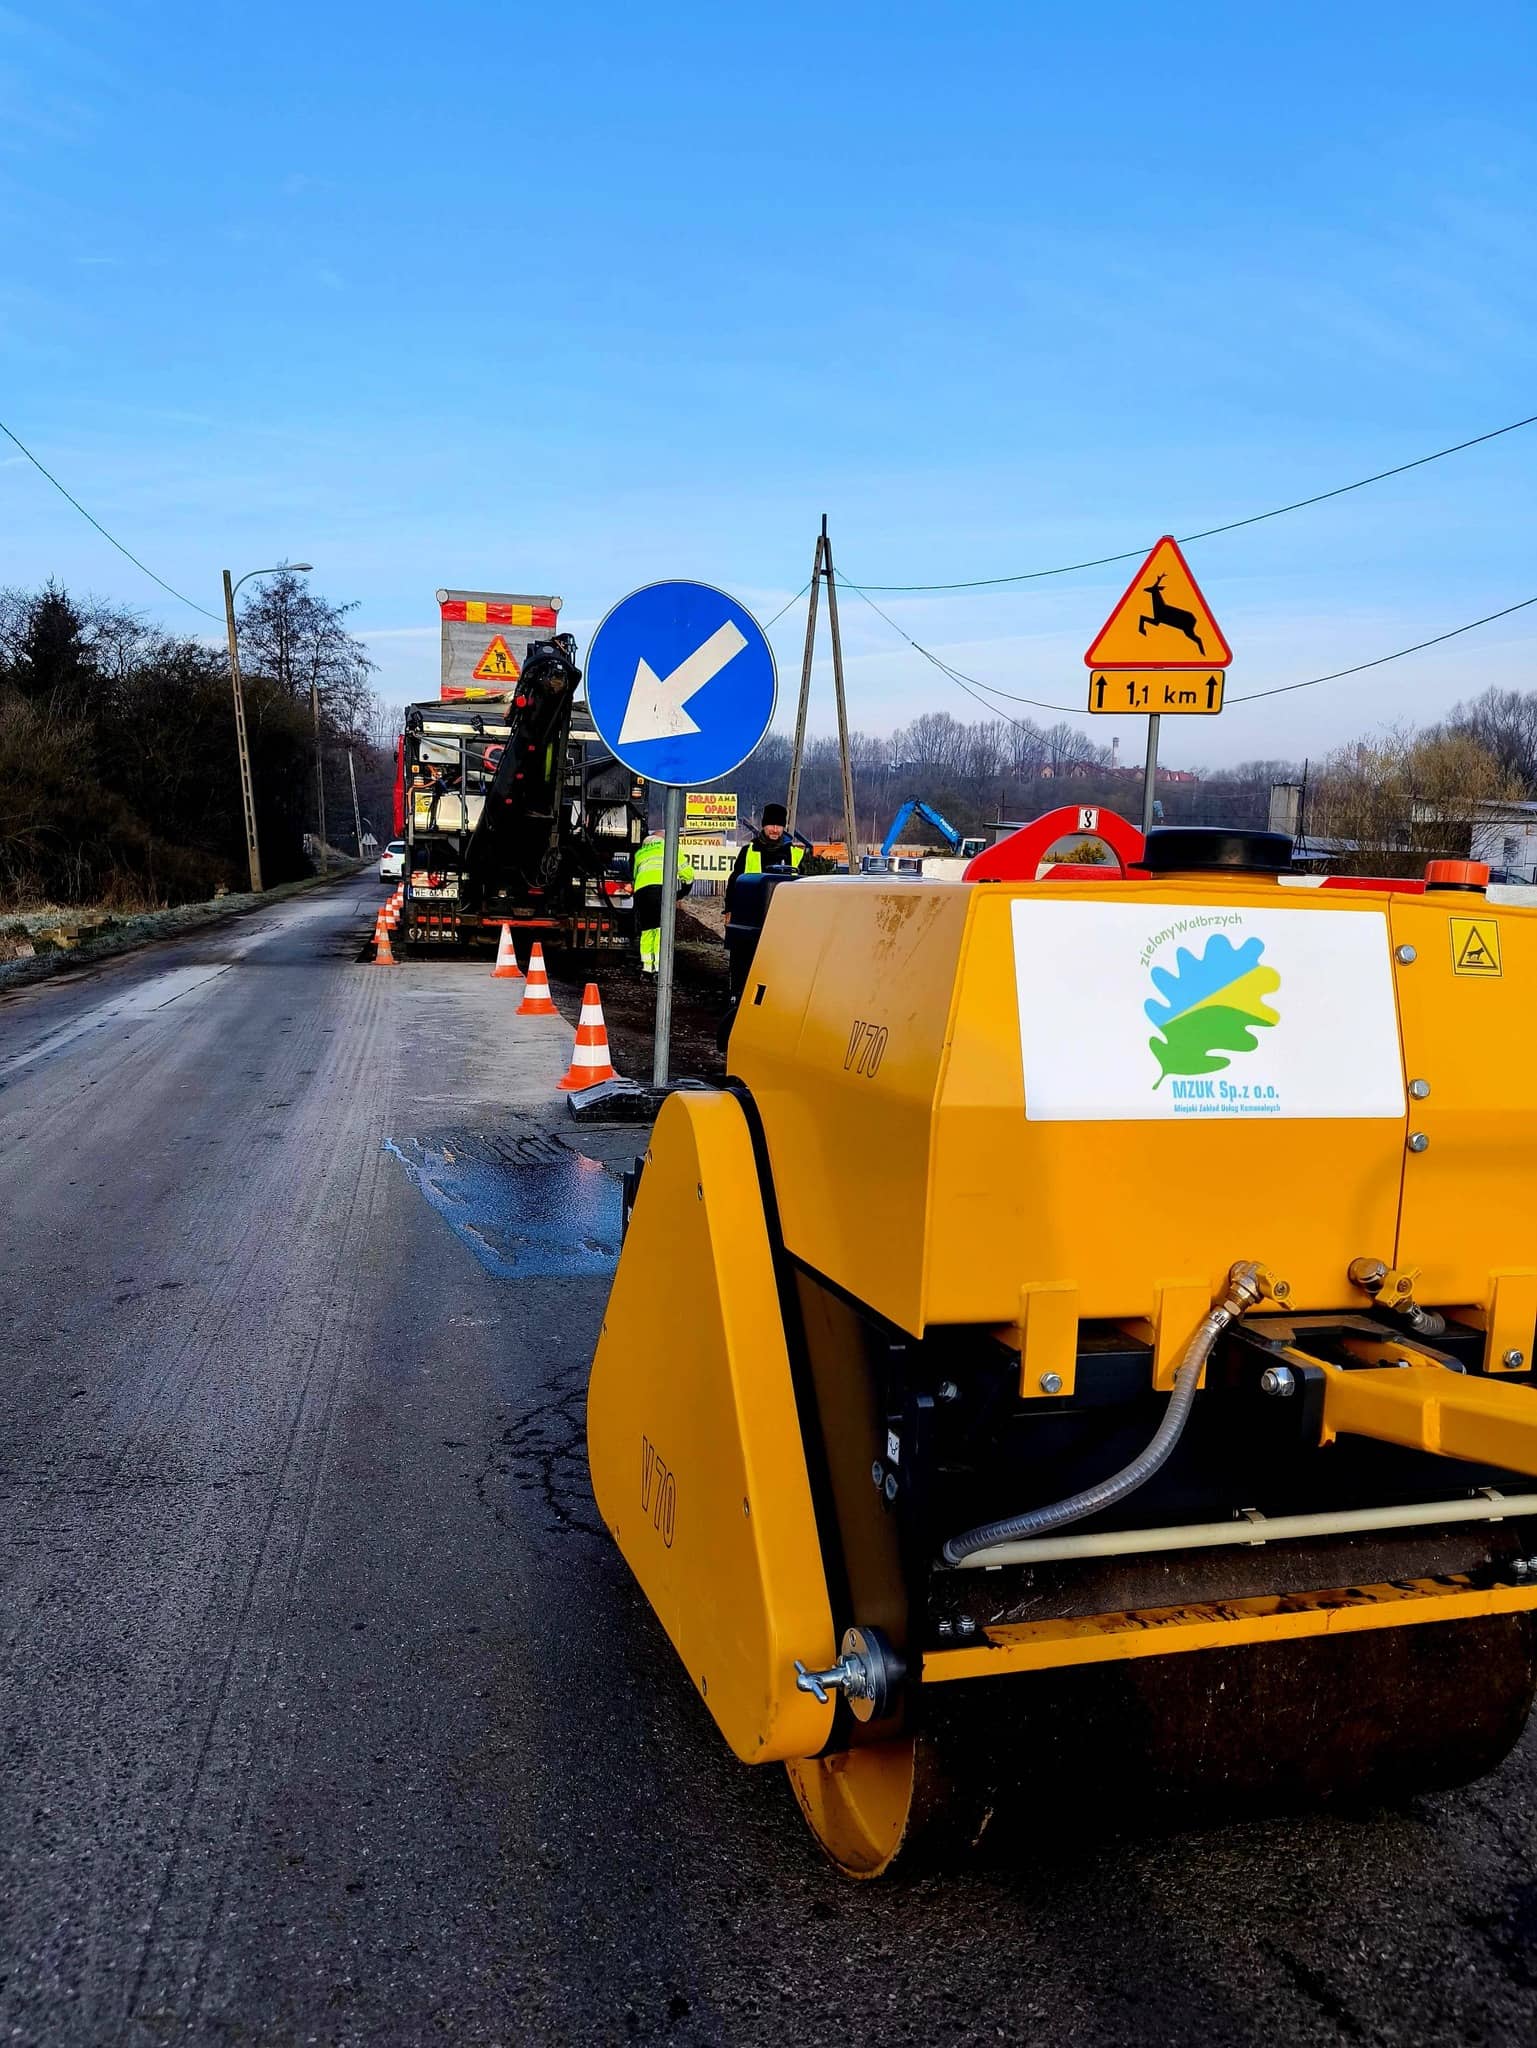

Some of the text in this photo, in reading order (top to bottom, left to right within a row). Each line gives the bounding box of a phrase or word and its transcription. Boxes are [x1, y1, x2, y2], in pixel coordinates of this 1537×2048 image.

[1126, 681, 1197, 707] 1,1 km
[704, 804, 736, 815] OPAŁU
[679, 838, 721, 846] RUSZYWA
[1172, 1080, 1215, 1098] MZUK
[1253, 1085, 1280, 1098] o.o.
